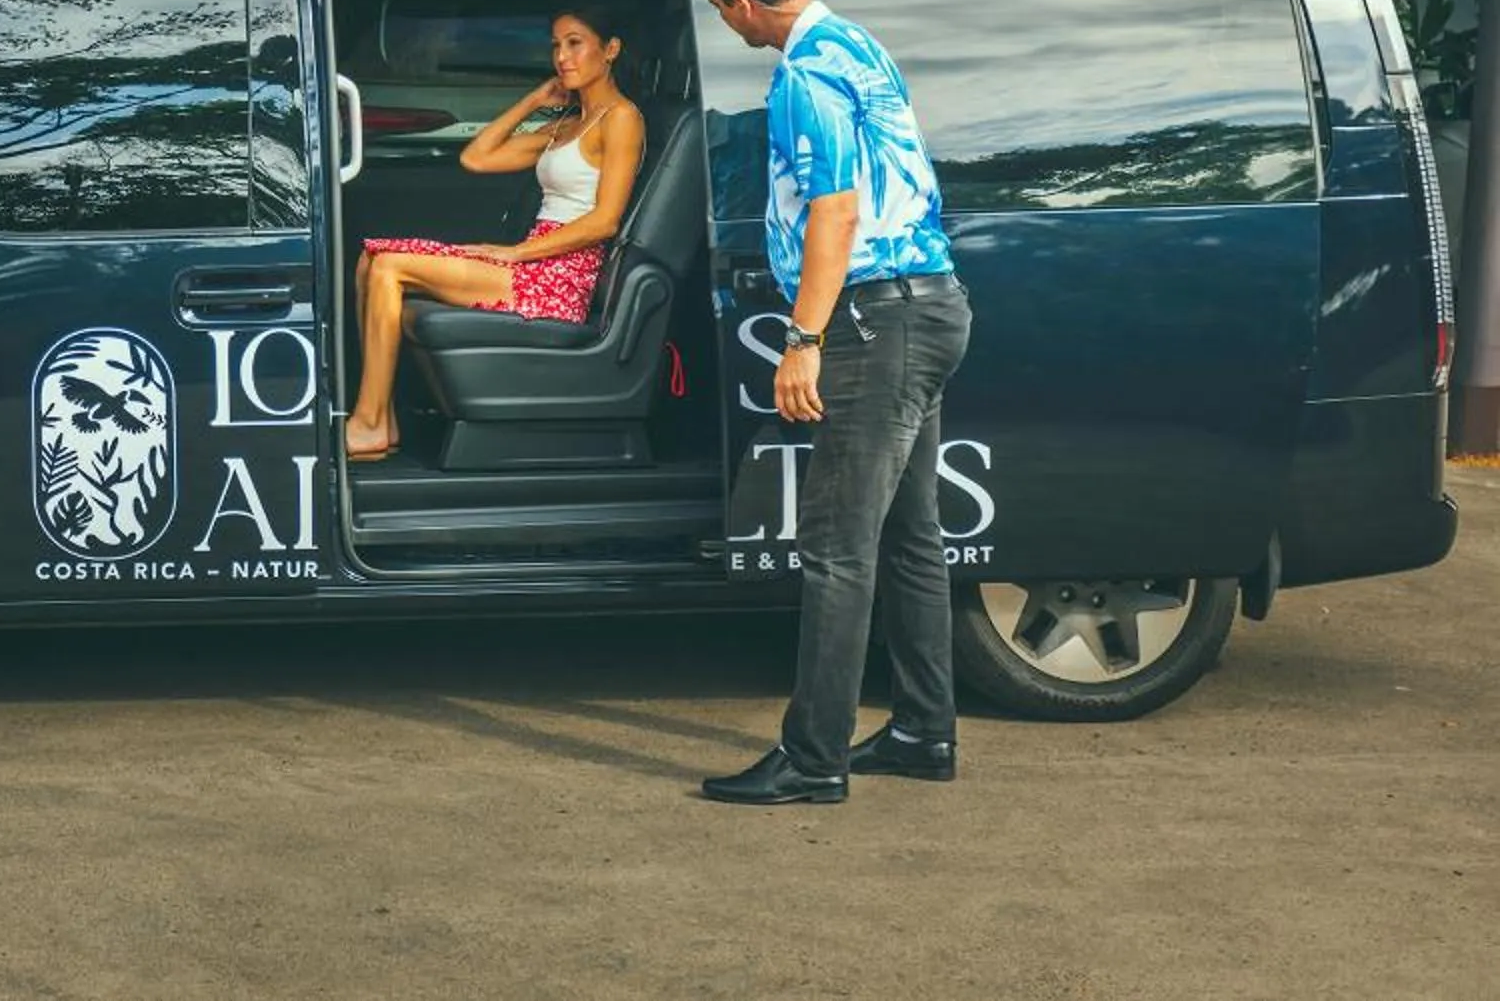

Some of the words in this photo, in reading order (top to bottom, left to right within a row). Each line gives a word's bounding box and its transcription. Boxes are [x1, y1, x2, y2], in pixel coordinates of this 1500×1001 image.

[758, 552, 776, 570] &
[943, 545, 995, 565] ORT
[35, 561, 121, 580] COSTA
[133, 561, 195, 579] RICA
